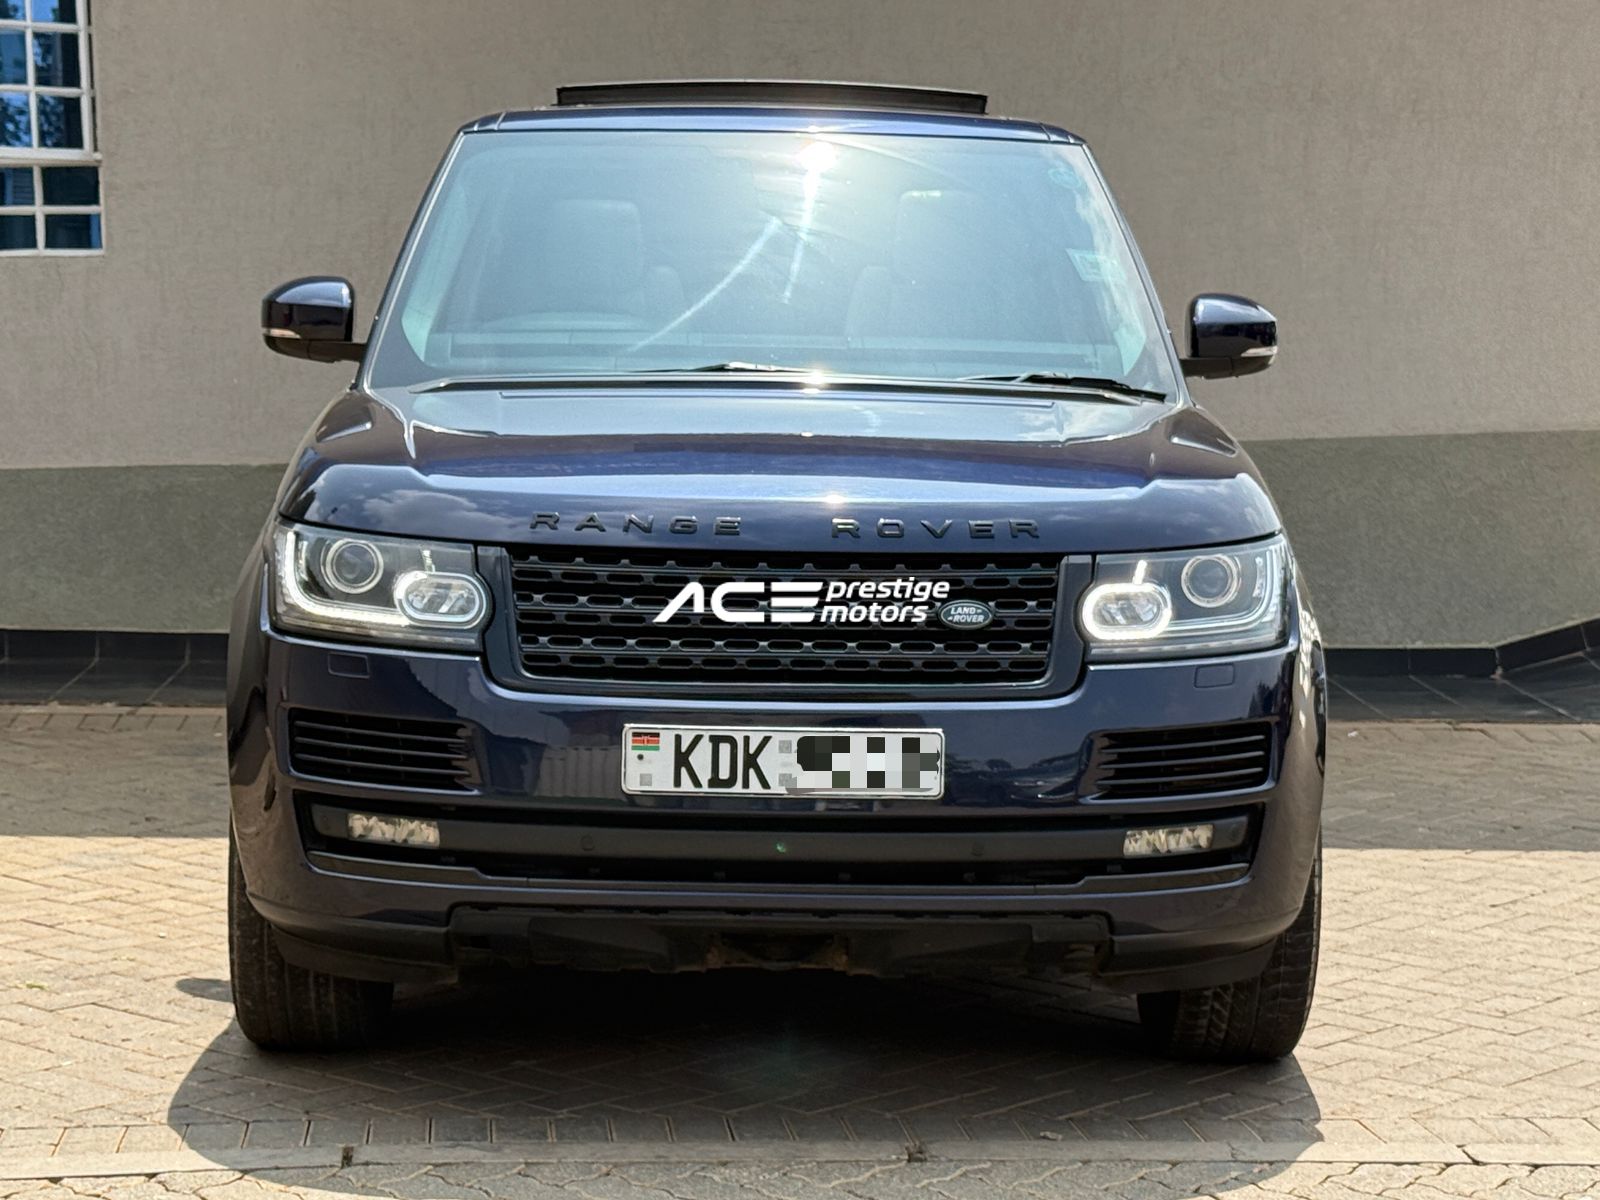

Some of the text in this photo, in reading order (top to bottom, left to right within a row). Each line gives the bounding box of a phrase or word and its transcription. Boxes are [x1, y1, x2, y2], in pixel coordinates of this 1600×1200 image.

[529, 511, 1040, 540] RANGE ROVER
[673, 733, 773, 790] KDK
